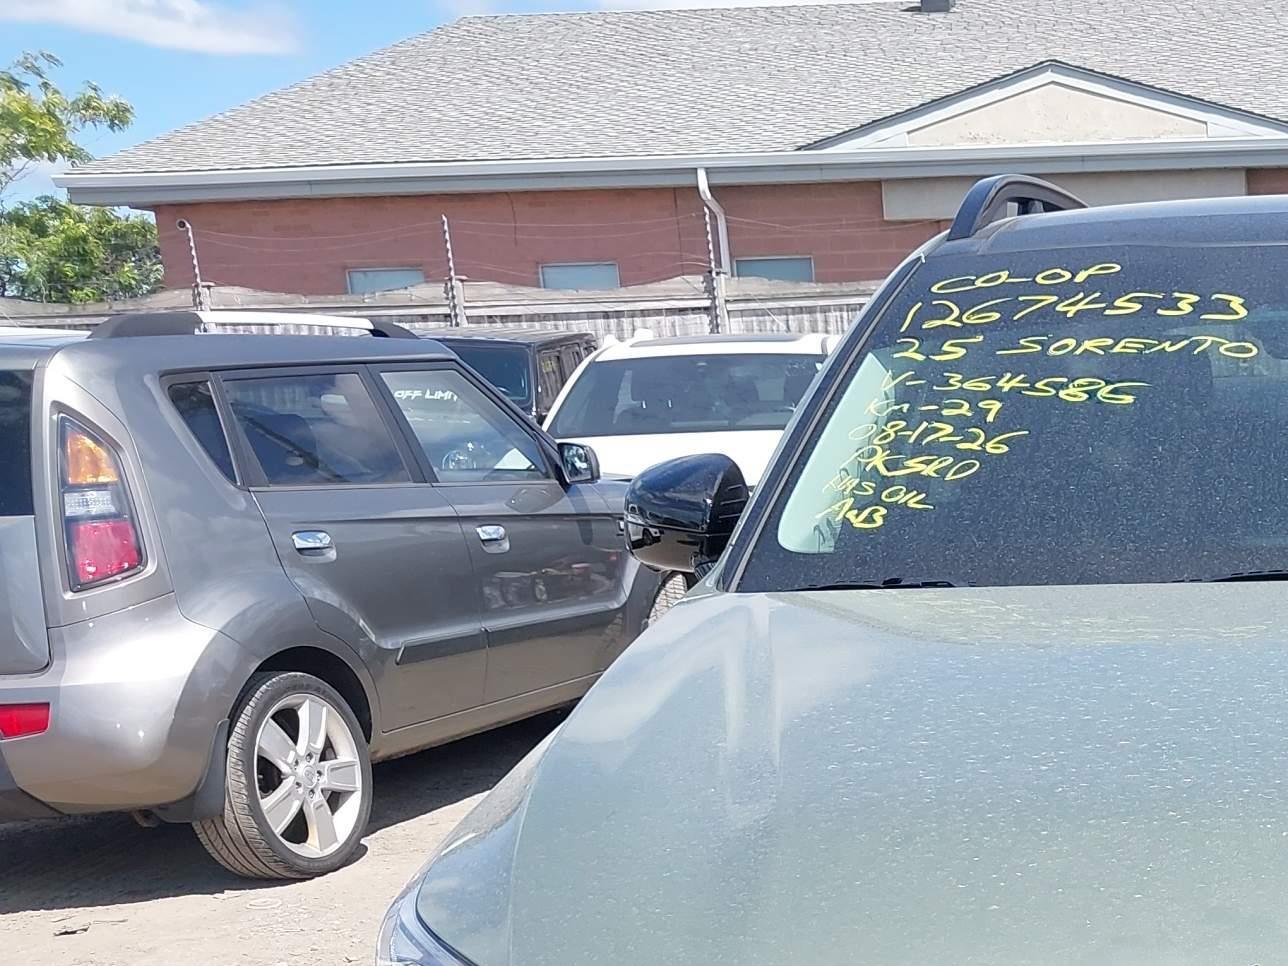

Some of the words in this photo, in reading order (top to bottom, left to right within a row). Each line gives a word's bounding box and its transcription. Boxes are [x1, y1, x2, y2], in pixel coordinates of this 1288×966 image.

[930, 263, 1122, 294] CO-OP
[899, 291, 1251, 333] 12674533
[892, 335, 984, 362] 25
[995, 333, 1260, 359] SORENTO
[848, 420, 1030, 454] 08-17-26
